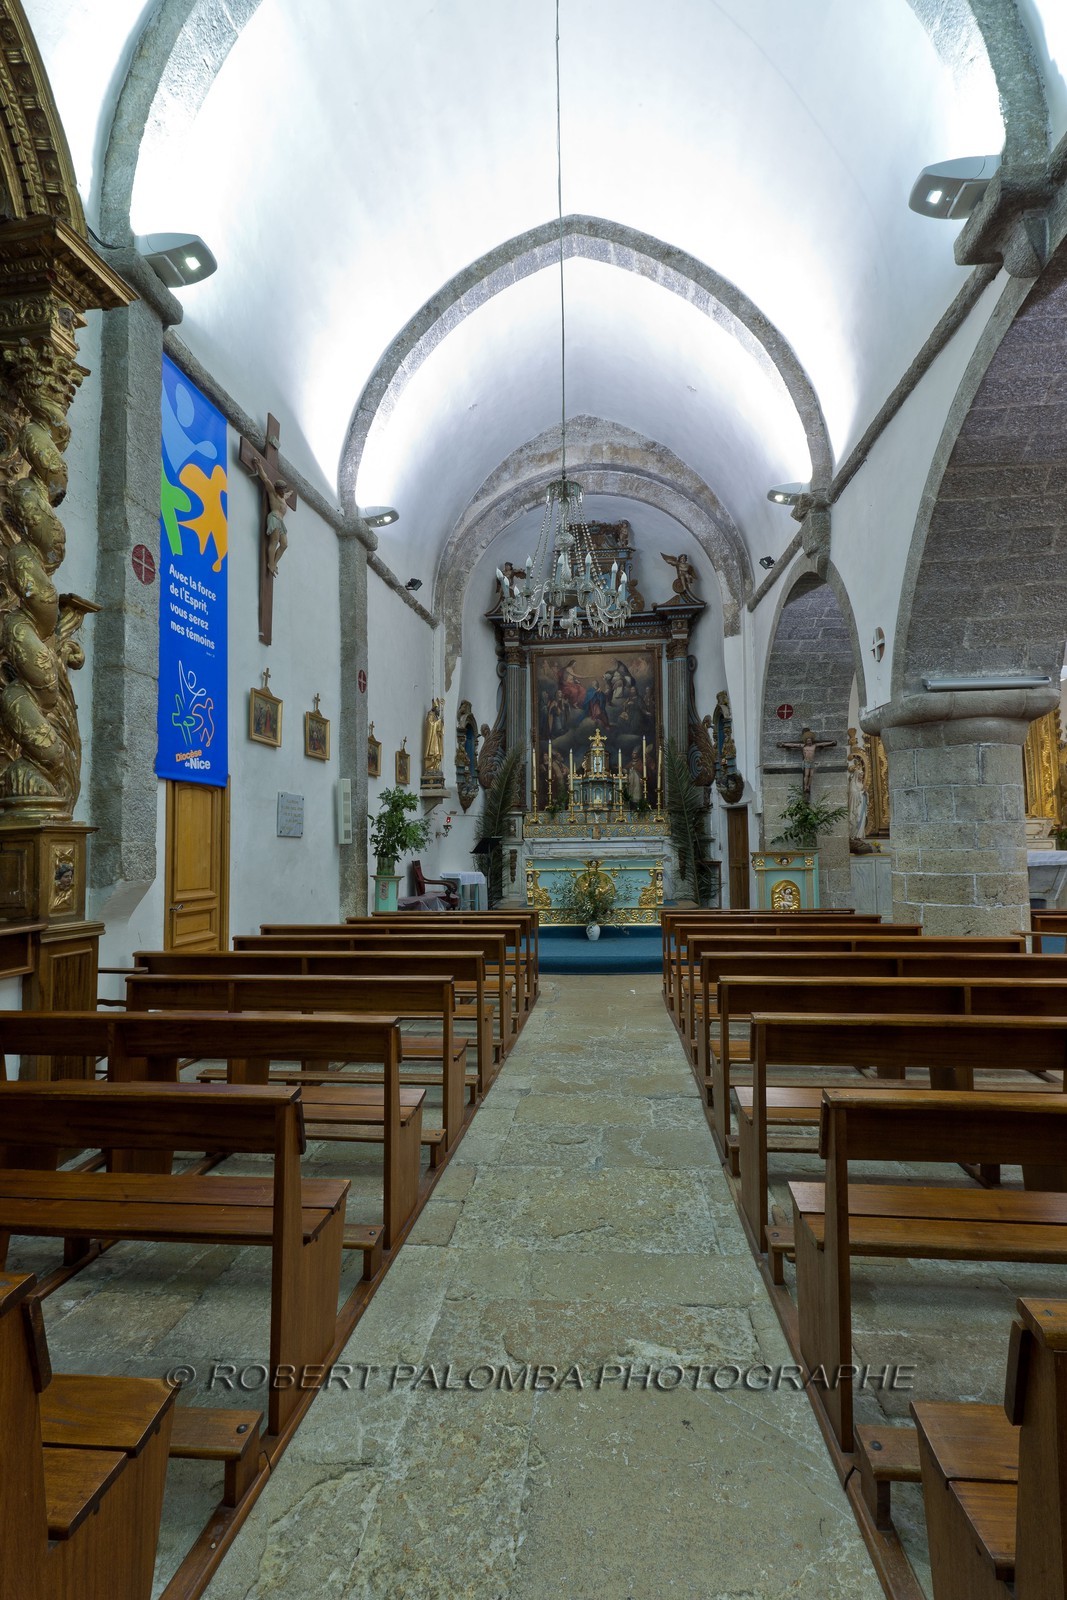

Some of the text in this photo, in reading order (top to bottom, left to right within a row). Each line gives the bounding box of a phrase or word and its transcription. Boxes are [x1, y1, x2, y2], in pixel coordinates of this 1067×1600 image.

[169, 563, 217, 601] Avec la force
[169, 582, 208, 614] de l'Esprit,
[170, 602, 209, 630] vous serez
[170, 620, 215, 650] mes témoins
[176, 750, 202, 762] Diocèse
[190, 758, 210, 770] Nice
